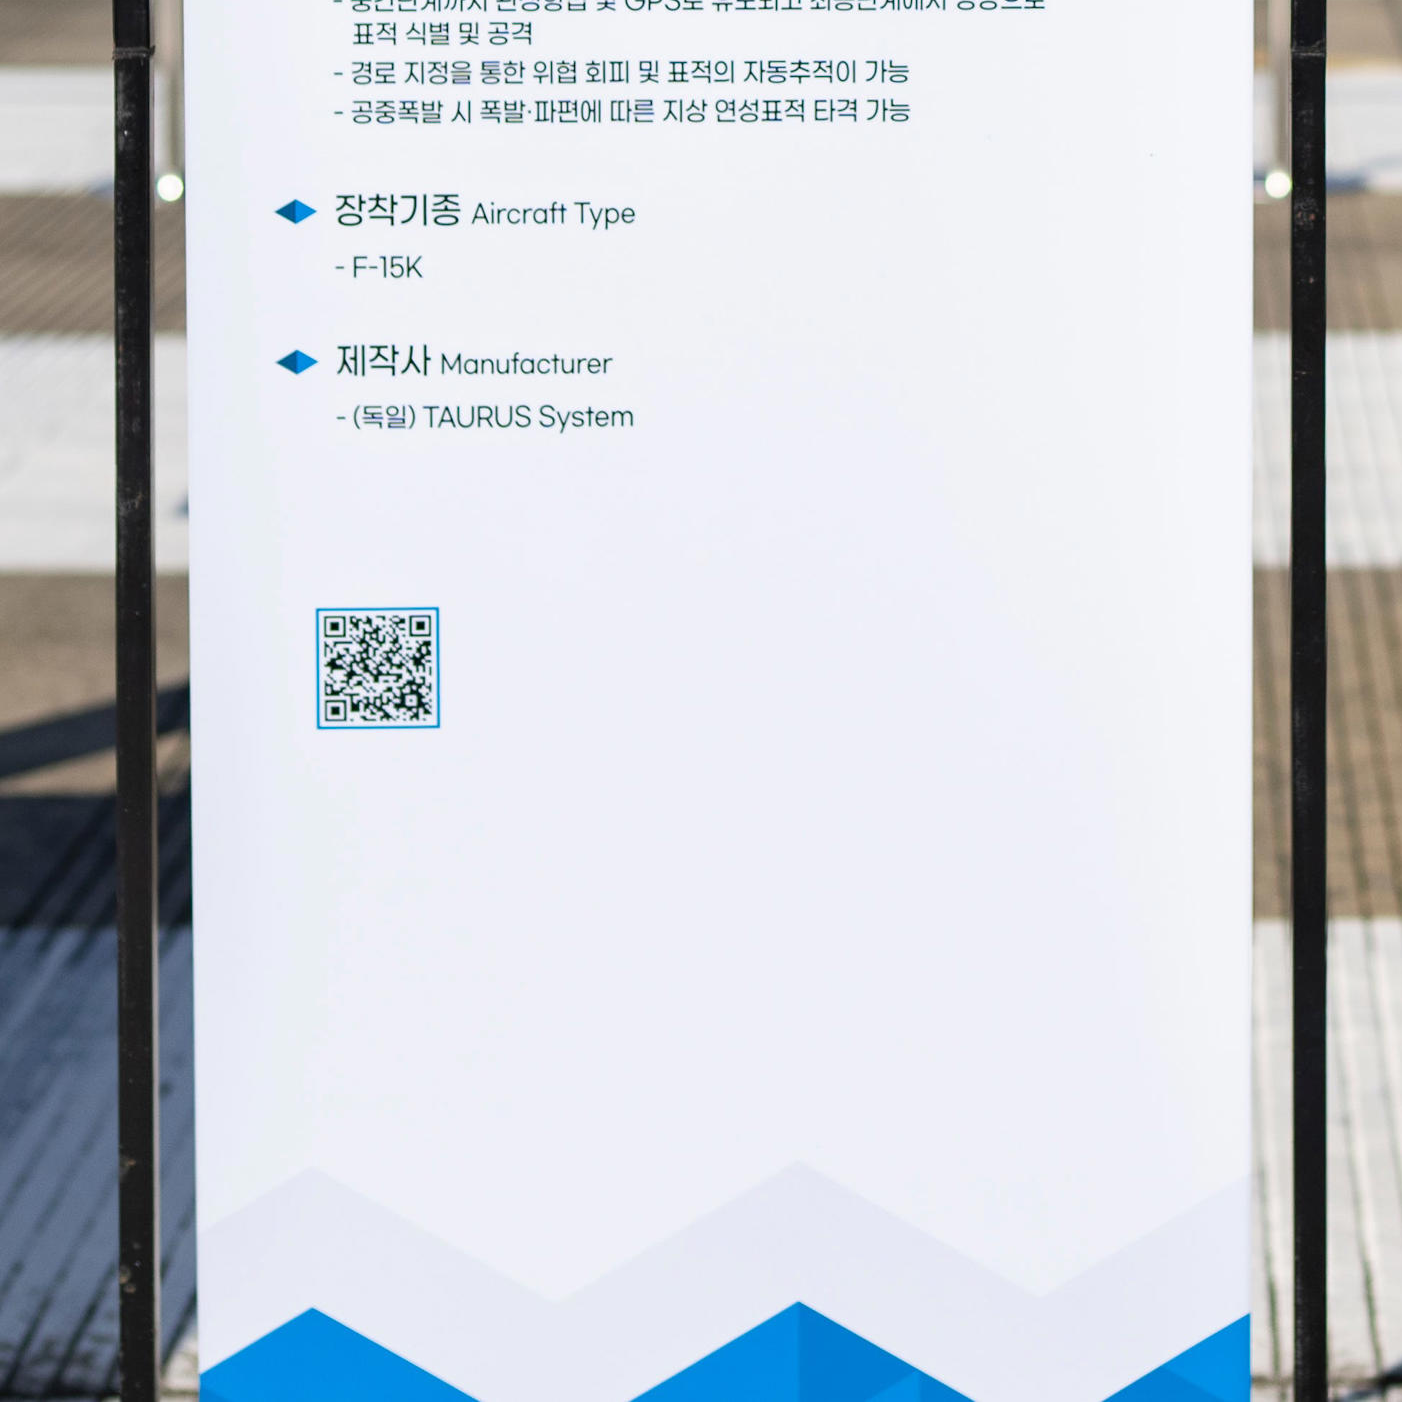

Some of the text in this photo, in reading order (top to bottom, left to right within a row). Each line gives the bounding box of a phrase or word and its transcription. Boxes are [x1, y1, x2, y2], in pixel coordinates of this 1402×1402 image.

[352, 21, 532, 46] 표적 식별 및 공격
[351, 61, 397, 86] 경로
[404, 60, 473, 86] 지정을
[479, 59, 527, 85] 통한
[532, 59, 577, 85] 위협
[585, 59, 630, 85] 회피
[638, 59, 660, 84] 및
[667, 59, 735, 84] 표적의
[743, 59, 856, 85] 자동추적이
[865, 59, 910, 84] 가능
[351, 99, 444, 125] 공중폭발
[450, 99, 472, 124] 시
[610, 98, 655, 124] 따른
[662, 98, 709, 124] 지상
[714, 98, 805, 124] 연성표적
[814, 98, 858, 123] 타격
[866, 98, 911, 123] 가능
[335, 193, 636, 231] 장착기종 Aircraft Type
[353, 255, 423, 279] F-15K
[336, 343, 614, 378] 제작사 Manufacturer
[422, 404, 532, 429] TAURUS
[538, 404, 634, 434] System
